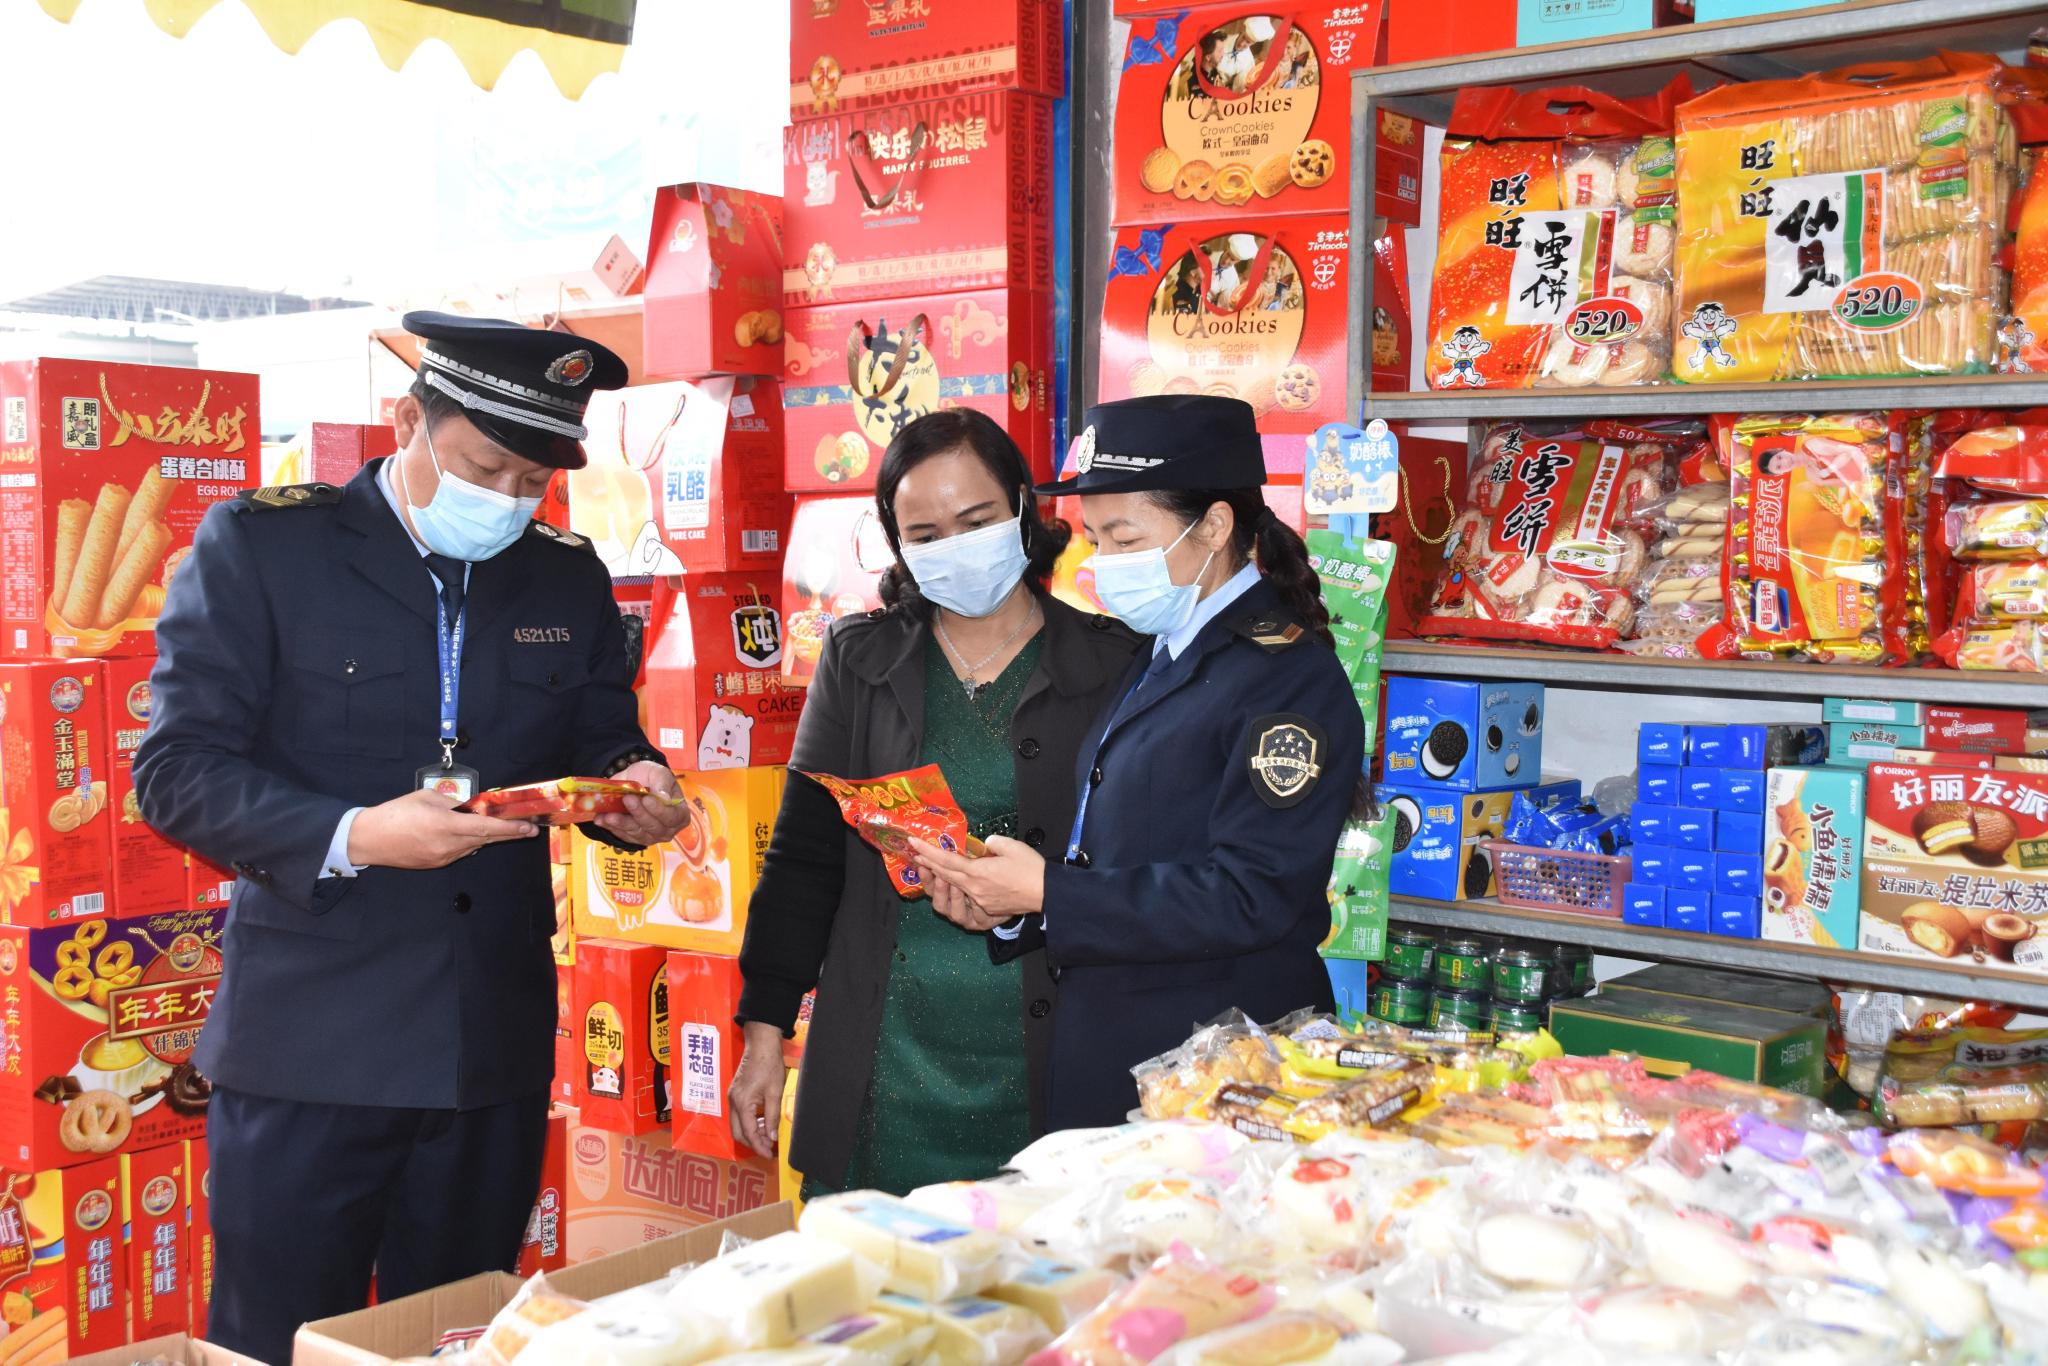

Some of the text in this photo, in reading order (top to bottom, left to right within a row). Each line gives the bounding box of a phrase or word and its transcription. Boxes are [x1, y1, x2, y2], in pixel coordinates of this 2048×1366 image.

[1200, 121, 1275, 136] CrownCookies
[882, 154, 971, 175] HAPPY SUIRREL
[1739, 140, 1777, 218] 旺旺
[1485, 173, 1530, 249] 旺旺
[1775, 196, 1842, 298] 仙贝
[1841, 285, 1913, 319] 520g
[1573, 310, 1634, 337] 520g
[109, 406, 248, 453] 八方来财
[1349, 440, 1394, 462] 奶酪棒
[1490, 429, 1523, 483] 美旺
[160, 456, 247, 481] 蛋卷合桃酥
[197, 485, 219, 496] EGG
[667, 470, 706, 501] 乳酪
[669, 529, 706, 541] PURE CAKE
[1754, 478, 1785, 572] 蛋黄派
[1322, 558, 1373, 583] 奶酪棒
[1555, 549, 1606, 568] 经济包
[513, 626, 571, 643] 4521175
[740, 616, 776, 652] 炖
[757, 696, 801, 714] CAKE
[1849, 729, 1899, 745] 小鱼糯糯
[1883, 767, 1915, 777] ORION
[1890, 773, 2048, 823] 好丽友·派
[604, 857, 654, 890] 蛋黄酥
[1803, 803, 1838, 912] 小鱼糯糯
[1840, 837, 1852, 880] 好丽友
[1877, 863, 1907, 873] ORION
[5, 984, 22, 1076] 年年大发
[588, 1016, 622, 1051] 鲜切
[90, 1237, 114, 1312] 年年旺
[154, 1222, 178, 1294] 年年旺
